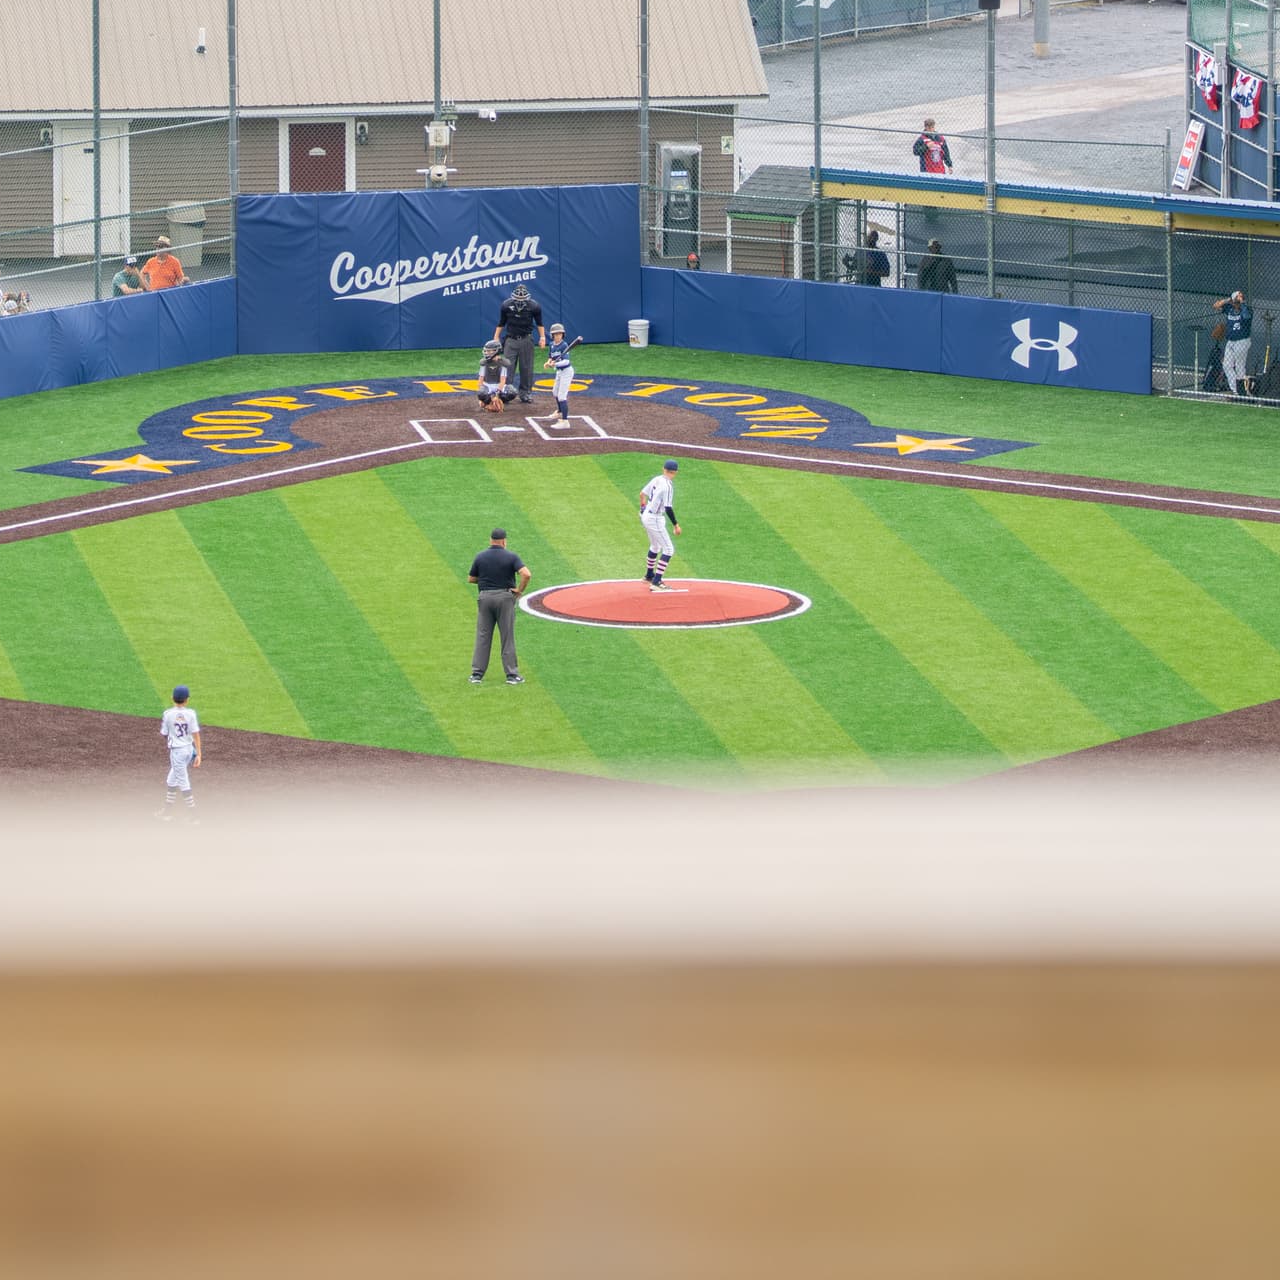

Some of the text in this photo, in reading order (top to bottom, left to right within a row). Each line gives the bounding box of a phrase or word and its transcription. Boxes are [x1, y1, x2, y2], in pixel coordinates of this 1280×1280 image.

[329, 235, 547, 295] Cooperstown
[442, 270, 536, 296] ALL STAR VILLAGE
